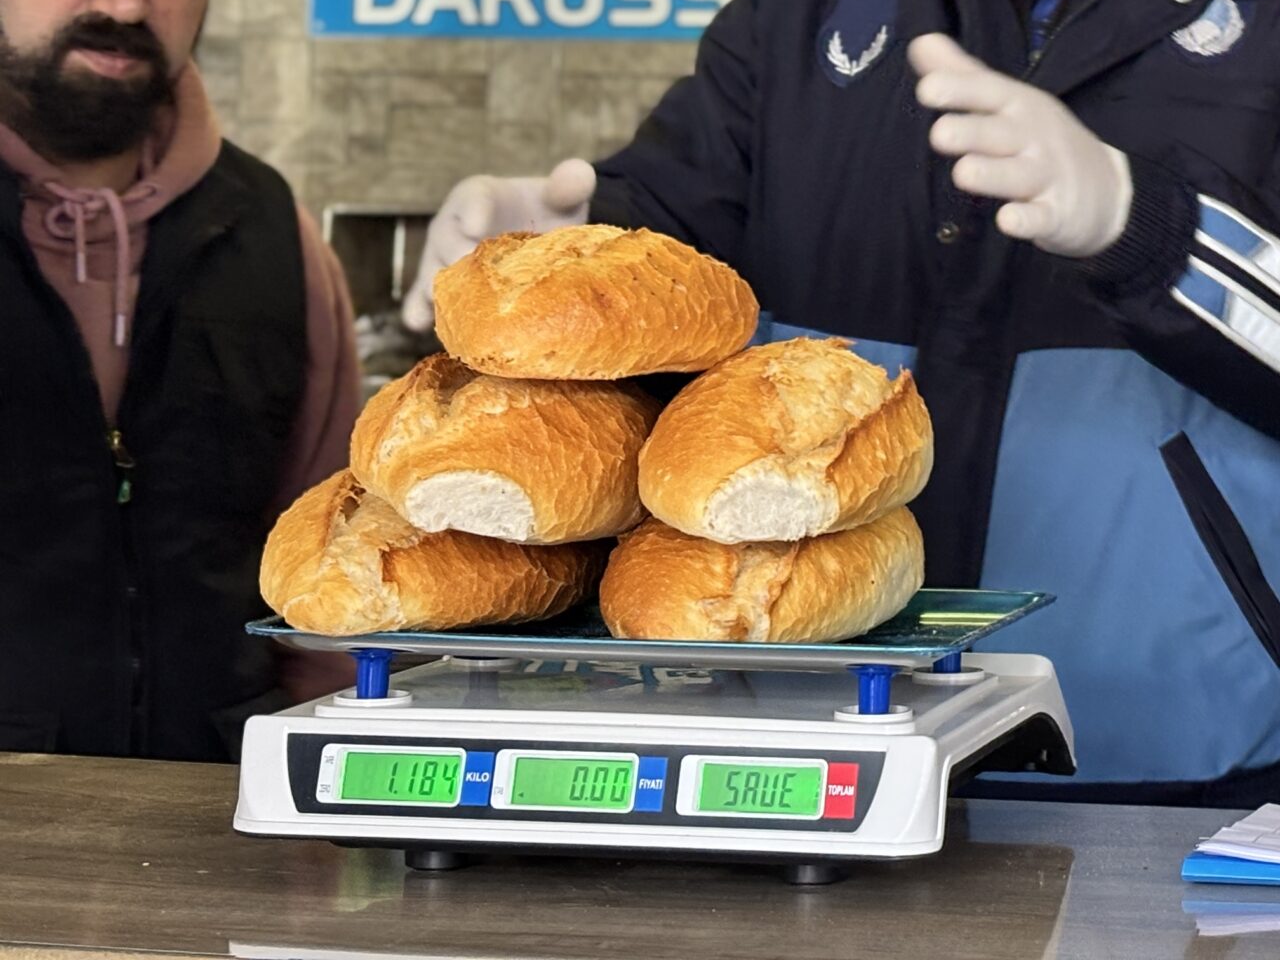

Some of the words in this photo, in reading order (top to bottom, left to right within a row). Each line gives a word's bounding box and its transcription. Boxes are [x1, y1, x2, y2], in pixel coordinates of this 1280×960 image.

[388, 760, 459, 796] 1.184
[465, 771, 490, 783] KILO
[569, 766, 630, 802] 0.00
[828, 784, 855, 796] TOPLAM
